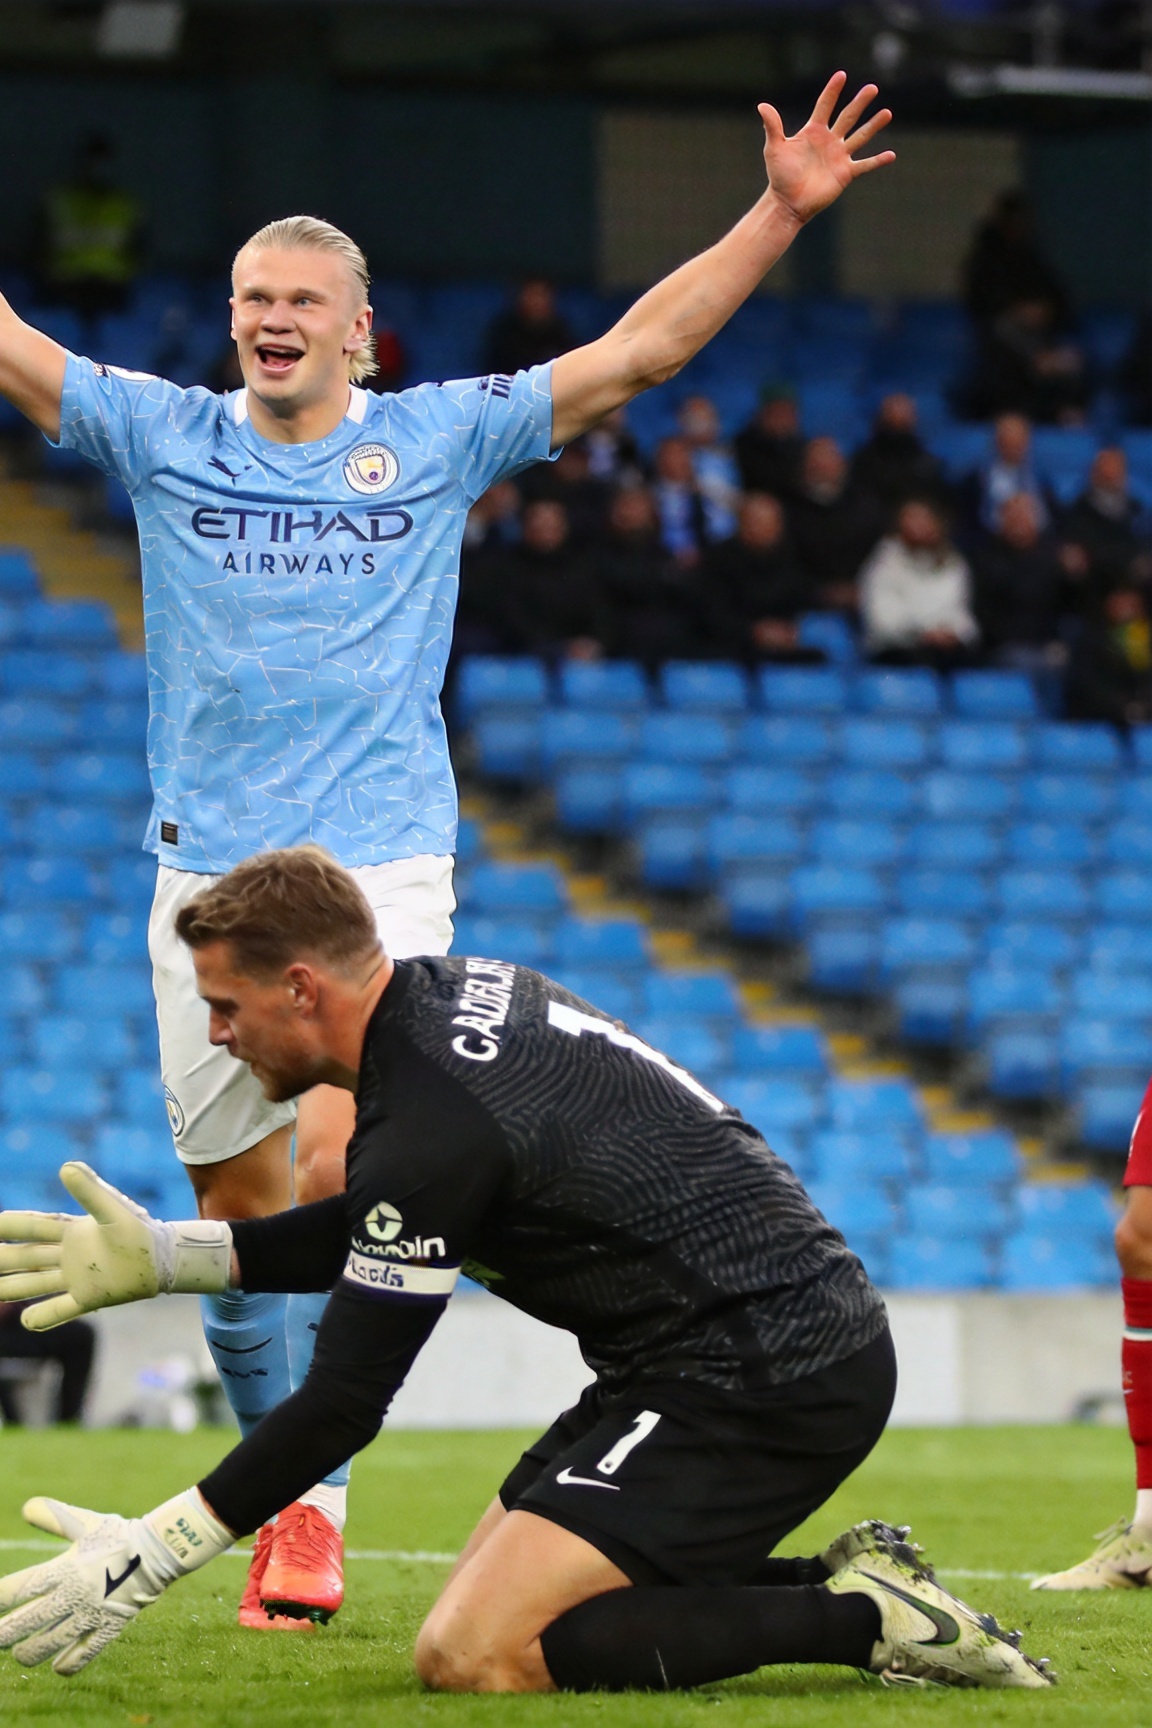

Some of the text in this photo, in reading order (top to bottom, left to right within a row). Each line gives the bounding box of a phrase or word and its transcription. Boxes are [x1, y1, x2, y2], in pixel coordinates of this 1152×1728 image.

[191, 506, 414, 542] ETIHAD
[222, 551, 376, 576] AIRWAYS
[596, 1409, 662, 1475] 1
